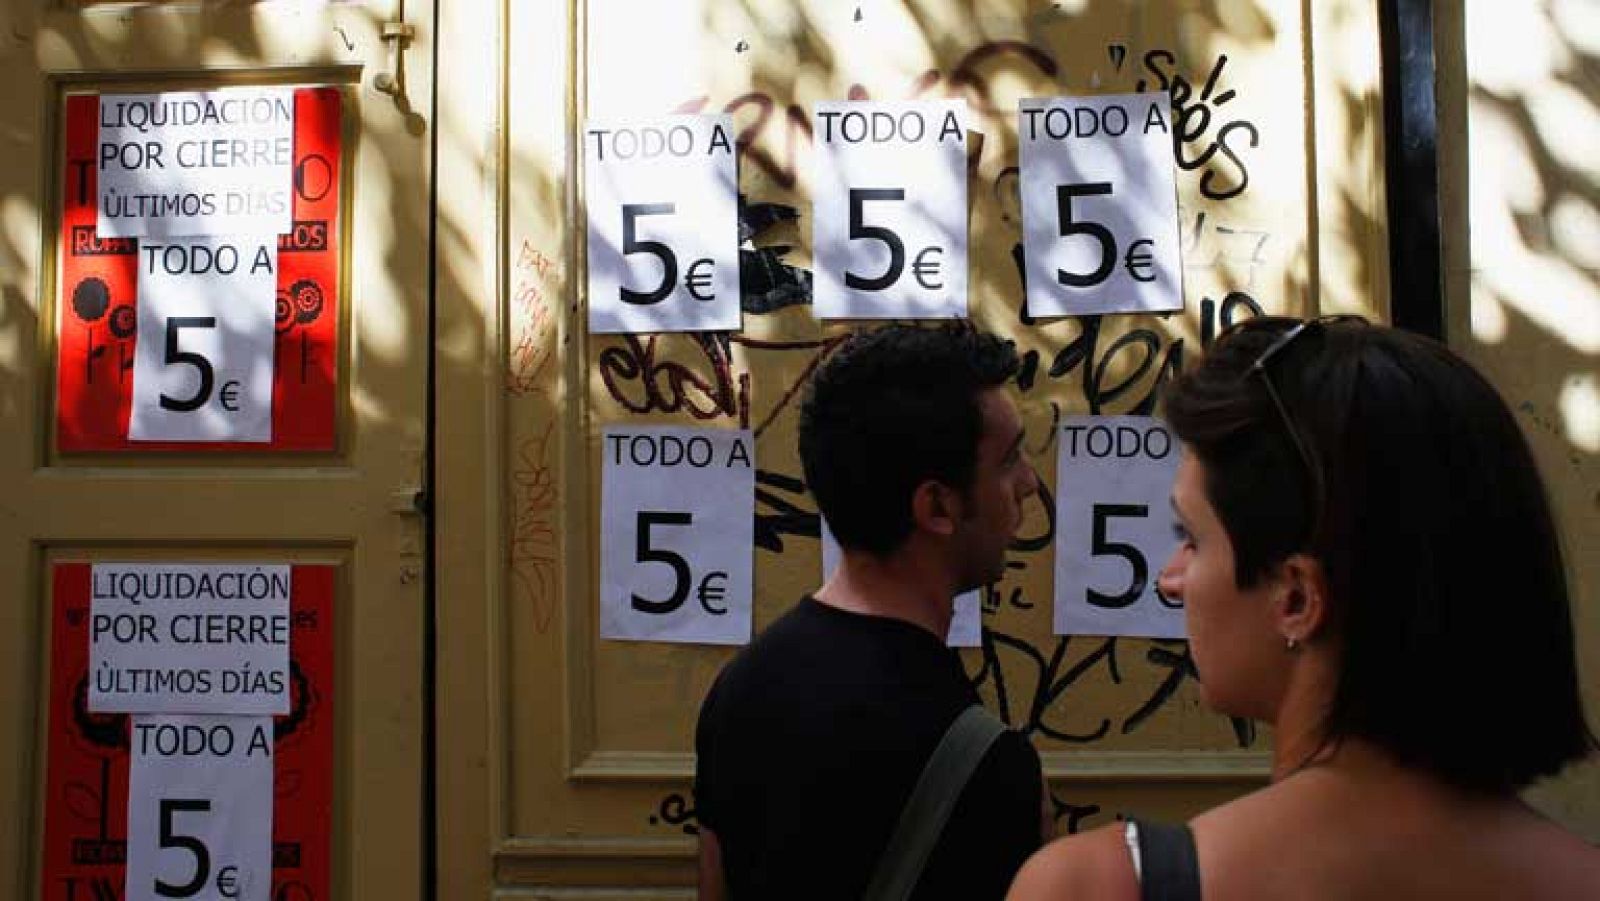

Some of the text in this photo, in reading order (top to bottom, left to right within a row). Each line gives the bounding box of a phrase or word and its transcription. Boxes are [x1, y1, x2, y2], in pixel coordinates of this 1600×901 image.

[818, 110, 963, 143] TODO A
[1022, 102, 1168, 141] TODO A
[101, 137, 290, 169] POR CIERRE
[589, 124, 732, 161] TODO A
[142, 245, 274, 275] TODO A
[607, 434, 751, 469] TODO A
[1064, 425, 1171, 460] TODO
[93, 613, 160, 644] POR
[169, 613, 288, 645] CIERRE
[221, 661, 285, 695] DÍAS
[135, 723, 271, 757] TODO A
